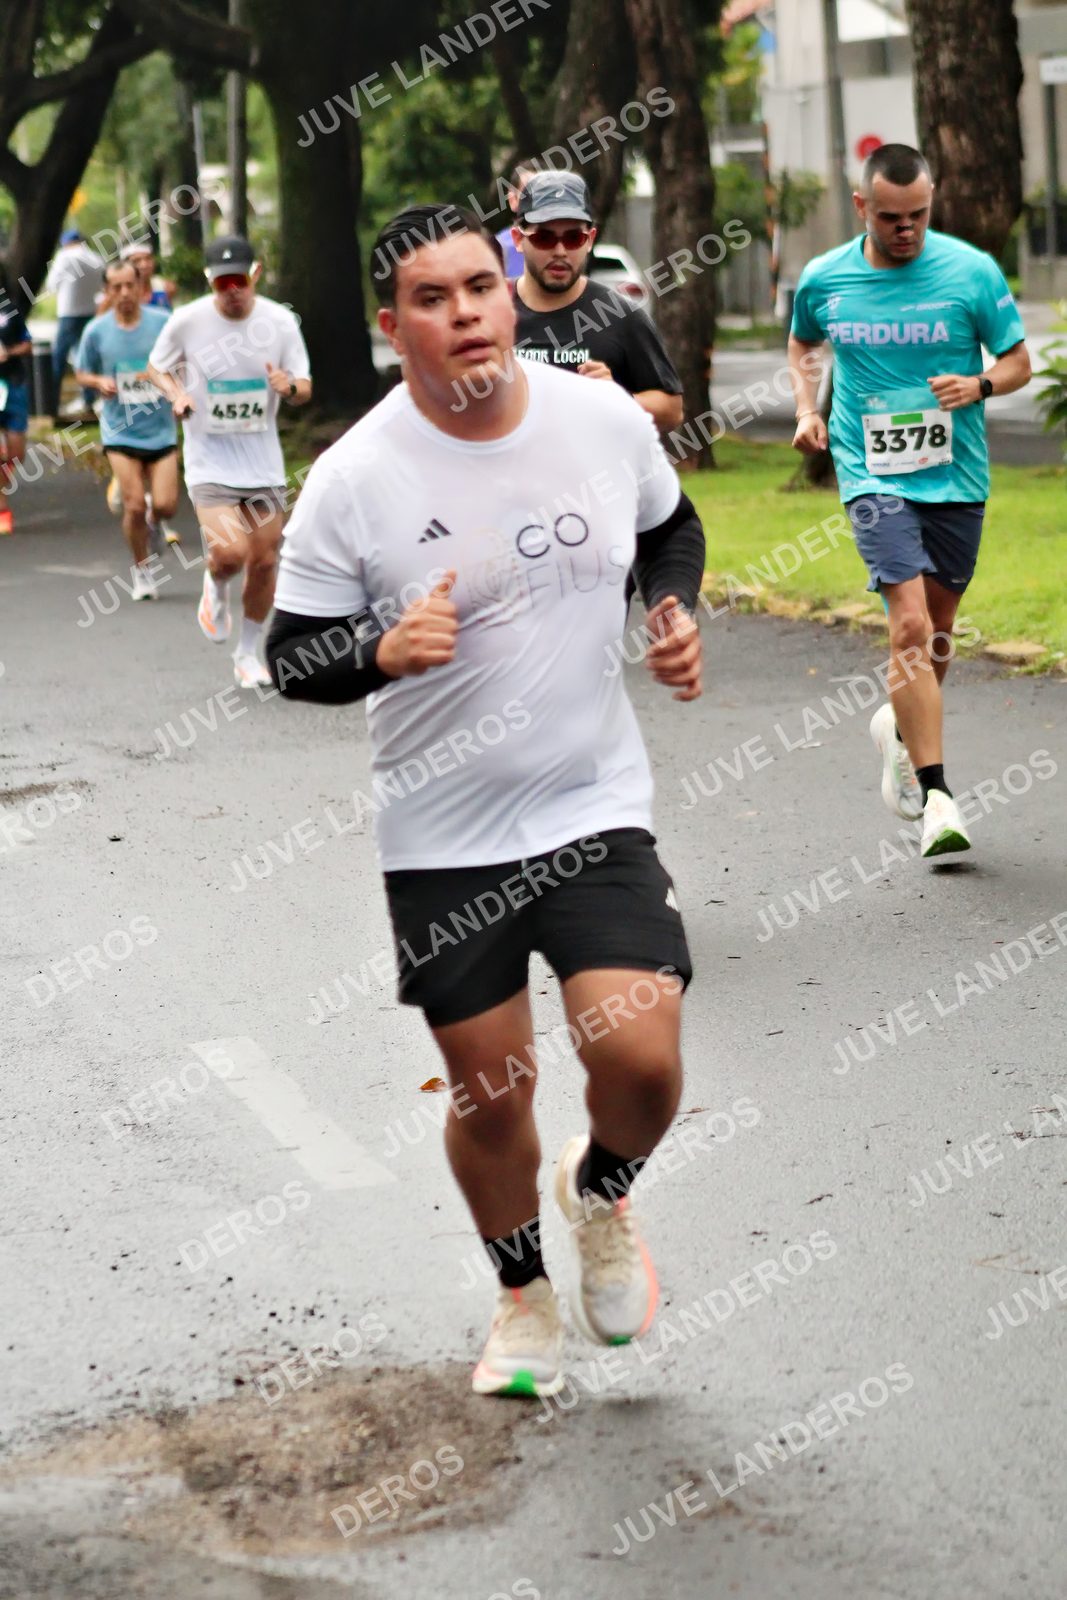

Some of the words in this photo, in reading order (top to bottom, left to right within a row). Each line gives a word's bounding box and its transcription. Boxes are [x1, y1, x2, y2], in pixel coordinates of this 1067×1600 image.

[827, 320, 950, 346] PERDURA
[553, 348, 590, 364] LOCAL
[212, 402, 264, 420] 4524
[870, 423, 947, 454] 3378
